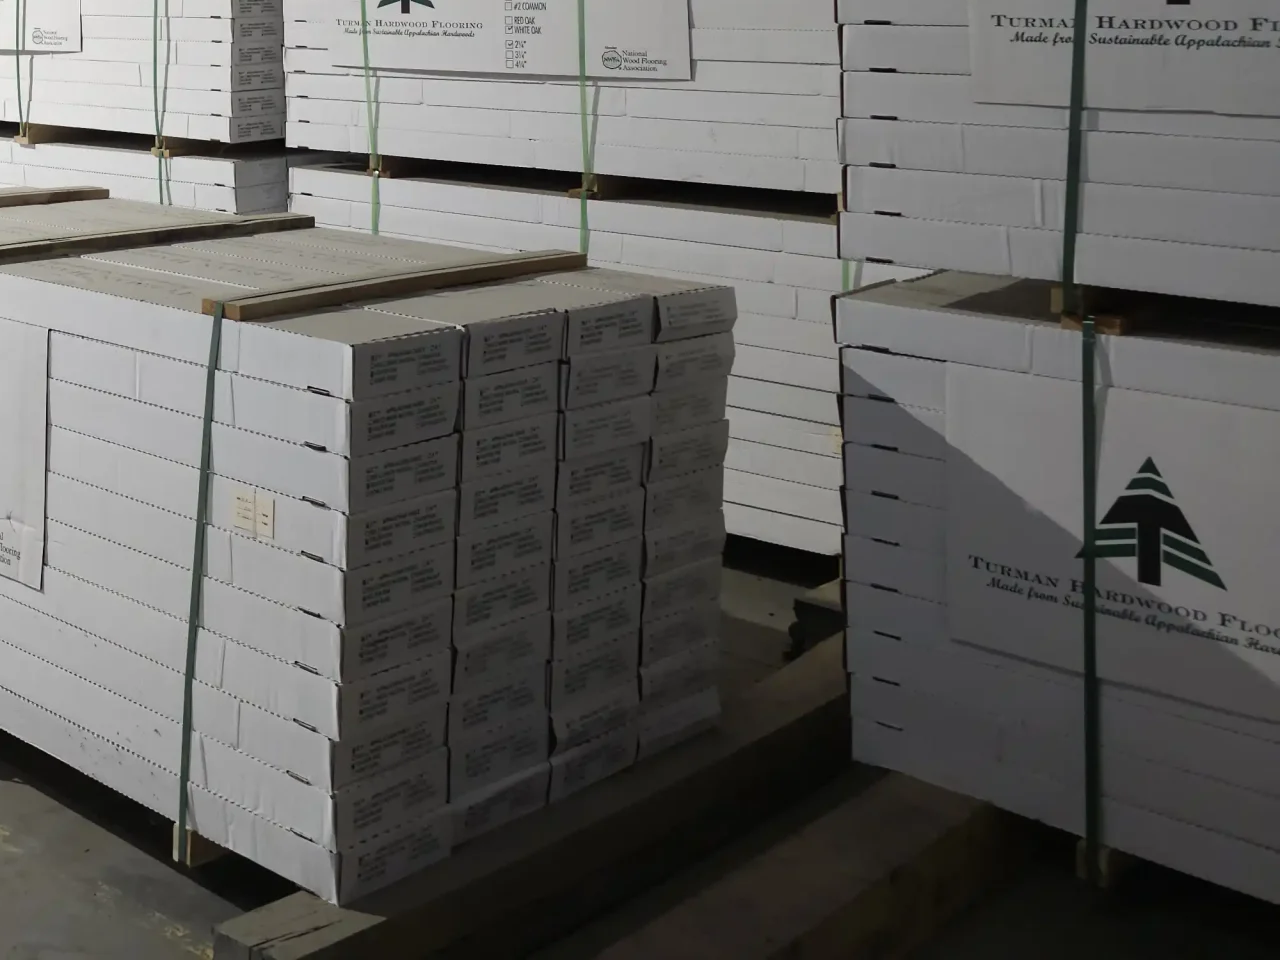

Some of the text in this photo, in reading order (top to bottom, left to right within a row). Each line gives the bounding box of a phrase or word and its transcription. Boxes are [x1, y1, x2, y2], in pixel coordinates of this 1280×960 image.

[513, 2, 547, 11] #2 COMMON
[375, 19, 428, 28] HARDWOOD
[431, 20, 483, 29] FLOORING
[514, 16, 536, 25] RED OAK
[1095, 15, 1239, 31] HARDWOOD
[514, 26, 542, 35] WHITE OAK
[1010, 31, 1049, 43] Made
[1052, 32, 1075, 47] fro
[1088, 32, 1170, 46] Sustainable
[1174, 34, 1271, 50] Appalachian
[641, 58, 668, 66] Flooring
[968, 553, 1059, 588] TURMAN
[986, 577, 1025, 595] Made
[1027, 587, 1059, 605] from
[1062, 594, 1141, 623] Susinable
[1144, 613, 1240, 646] Appalachian
